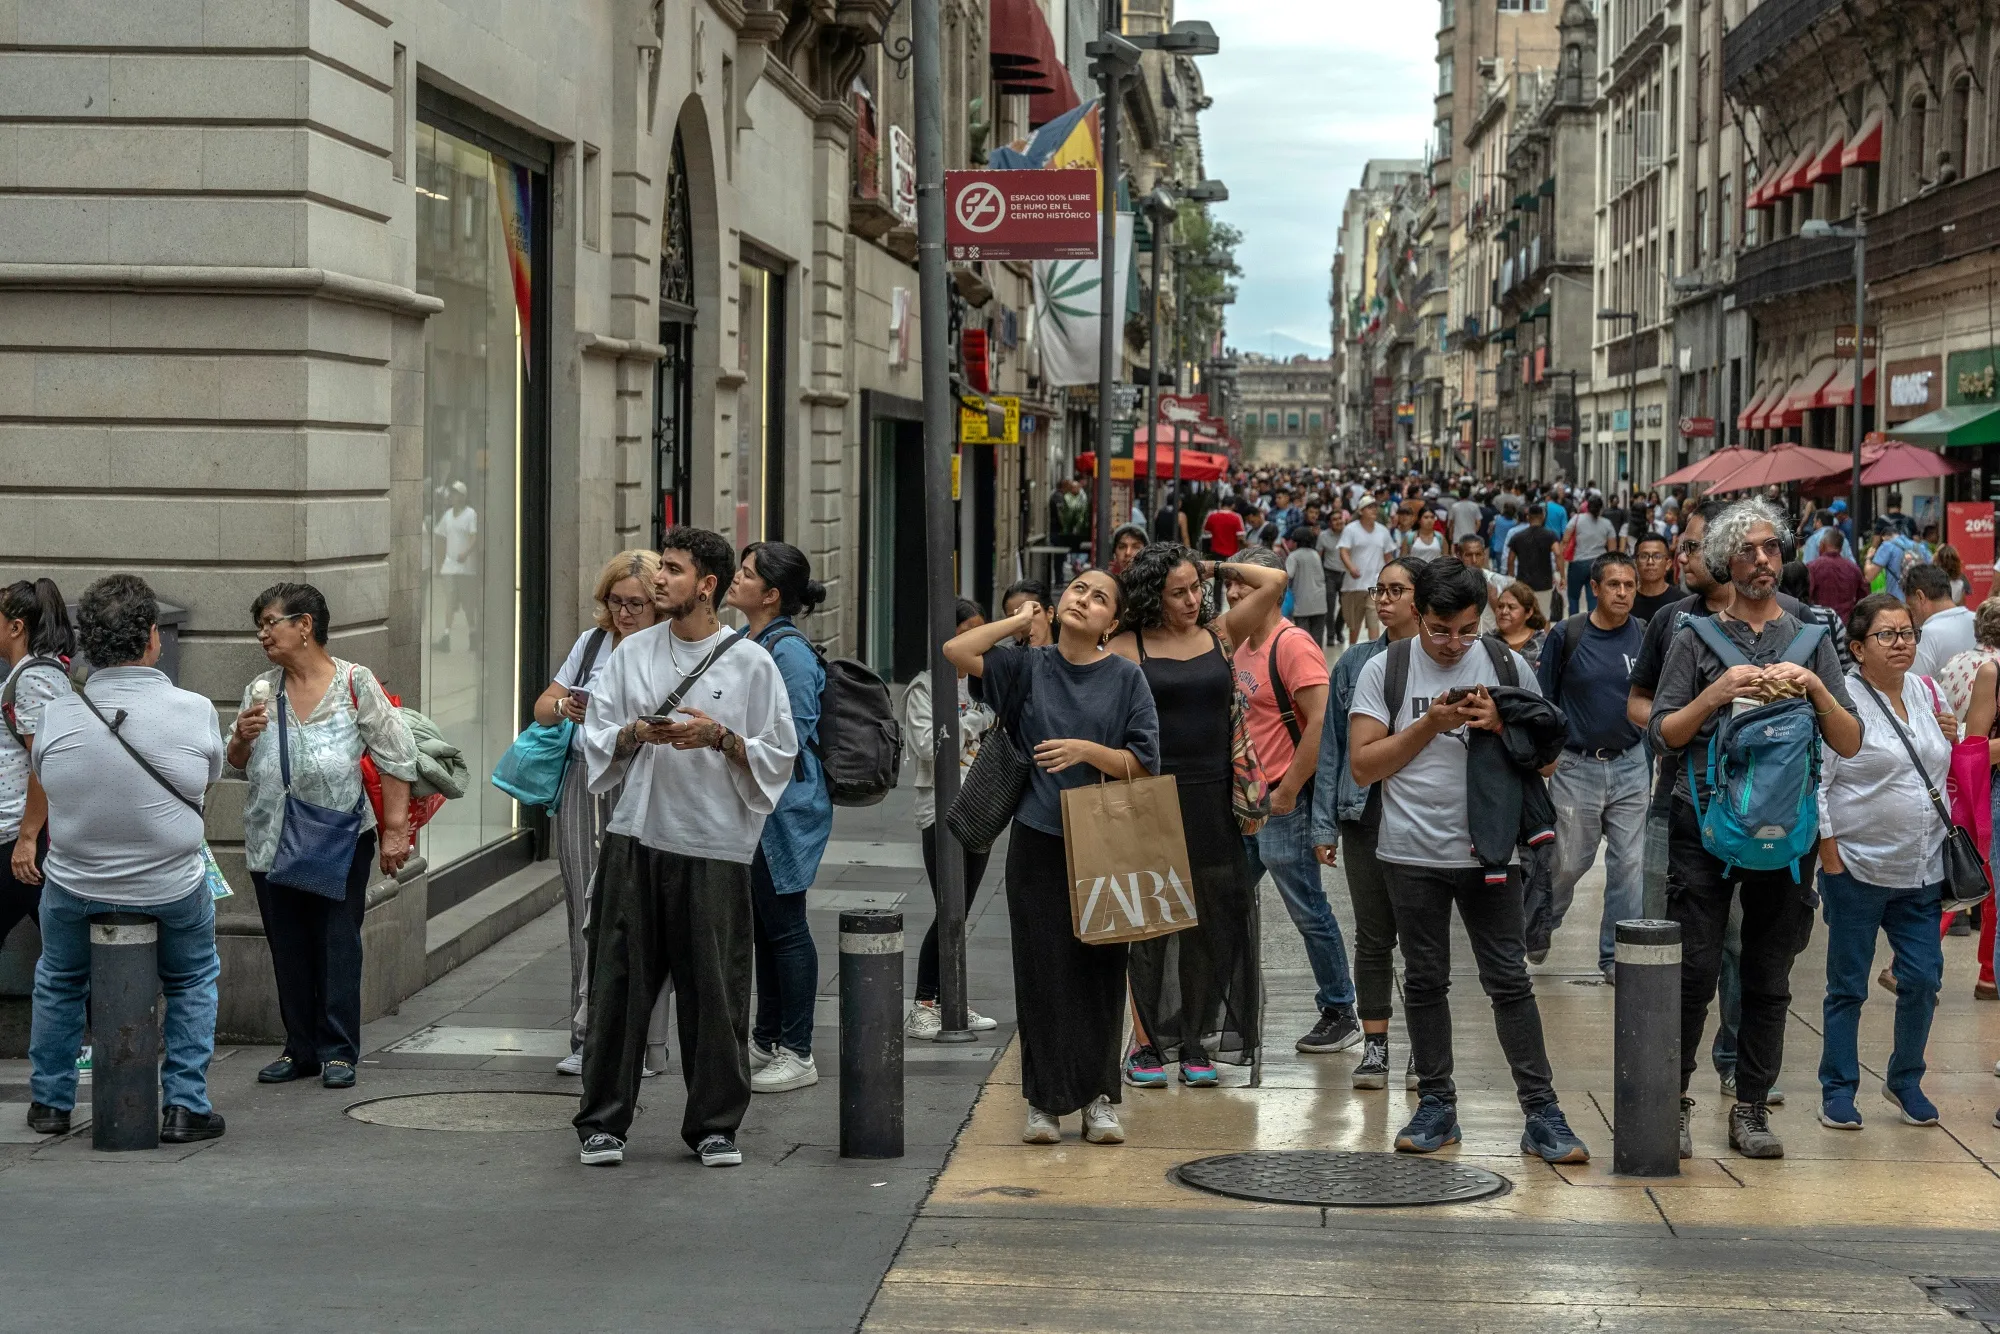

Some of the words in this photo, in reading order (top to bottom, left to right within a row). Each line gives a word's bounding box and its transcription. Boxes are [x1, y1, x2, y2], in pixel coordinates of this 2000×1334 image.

[1046, 211, 1091, 219] HISTÓRICO
[1965, 519, 1994, 532] 20%
[1075, 865, 1197, 935] ZARA
